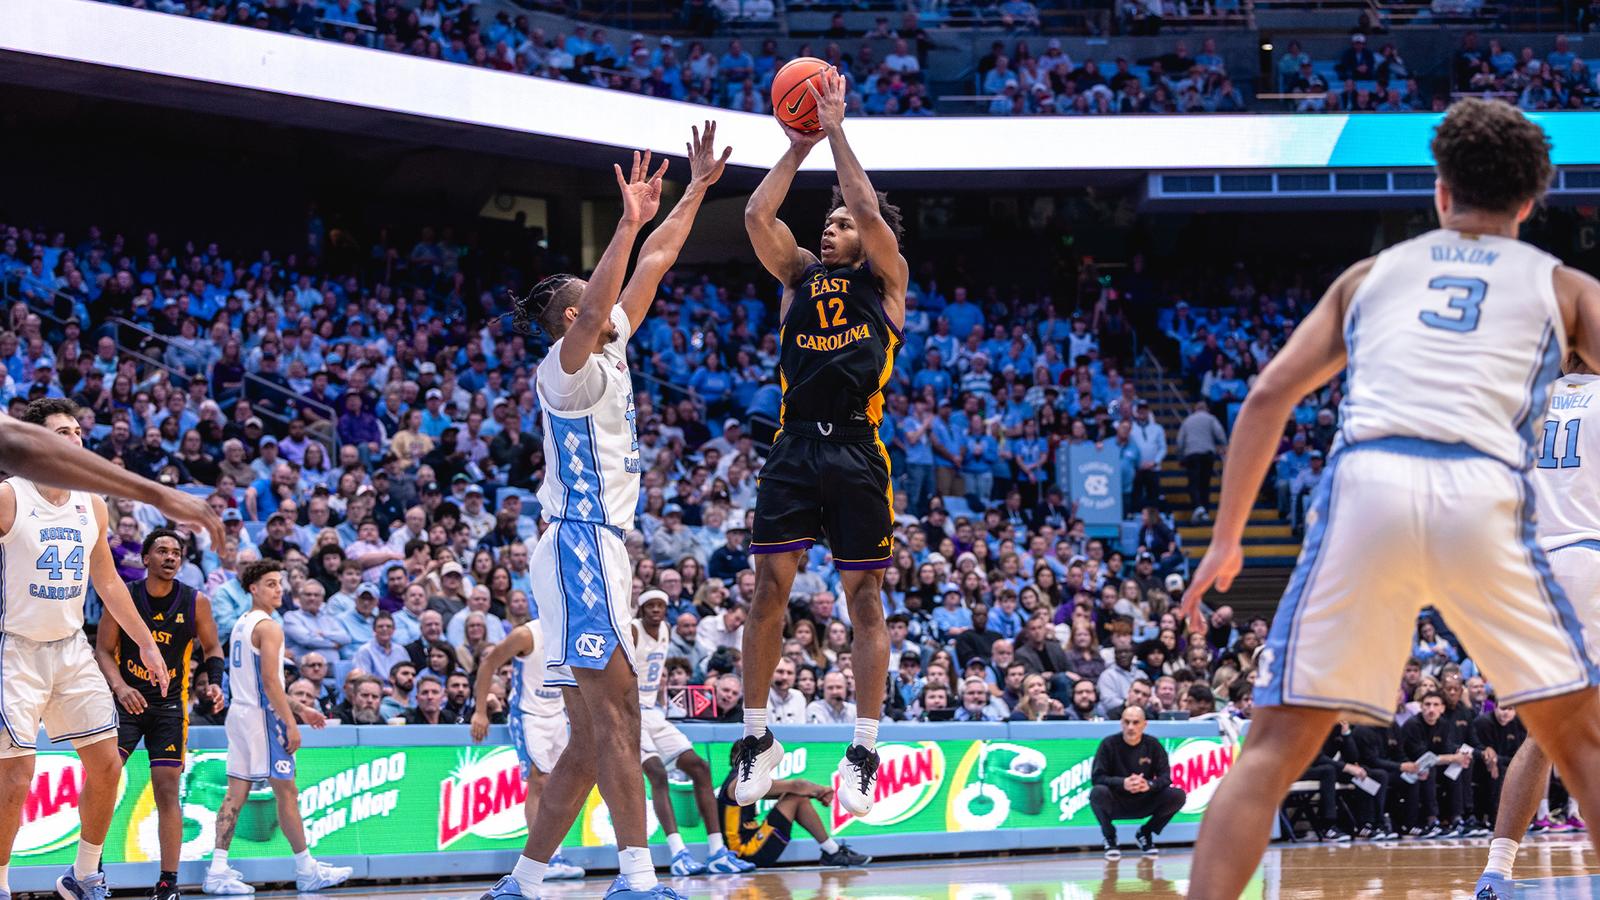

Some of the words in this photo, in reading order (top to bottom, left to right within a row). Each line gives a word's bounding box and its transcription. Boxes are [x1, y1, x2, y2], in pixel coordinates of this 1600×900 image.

[1431, 245, 1500, 266] DIXON
[810, 278, 850, 298] EAST
[1418, 274, 1489, 333] 3
[816, 297, 847, 329] 12
[796, 323, 872, 351] CAROLINA
[1552, 394, 1593, 410] OWELL
[1537, 418, 1581, 469] 11
[40, 527, 82, 543] NORTH
[36, 545, 84, 581] 44
[151, 630, 173, 645] AST
[233, 640, 242, 668] 0
[297, 752, 406, 820] ORNADO
[834, 748, 933, 830] LMAN
[350, 789, 400, 823] Mop
[441, 764, 529, 844] LIBM
